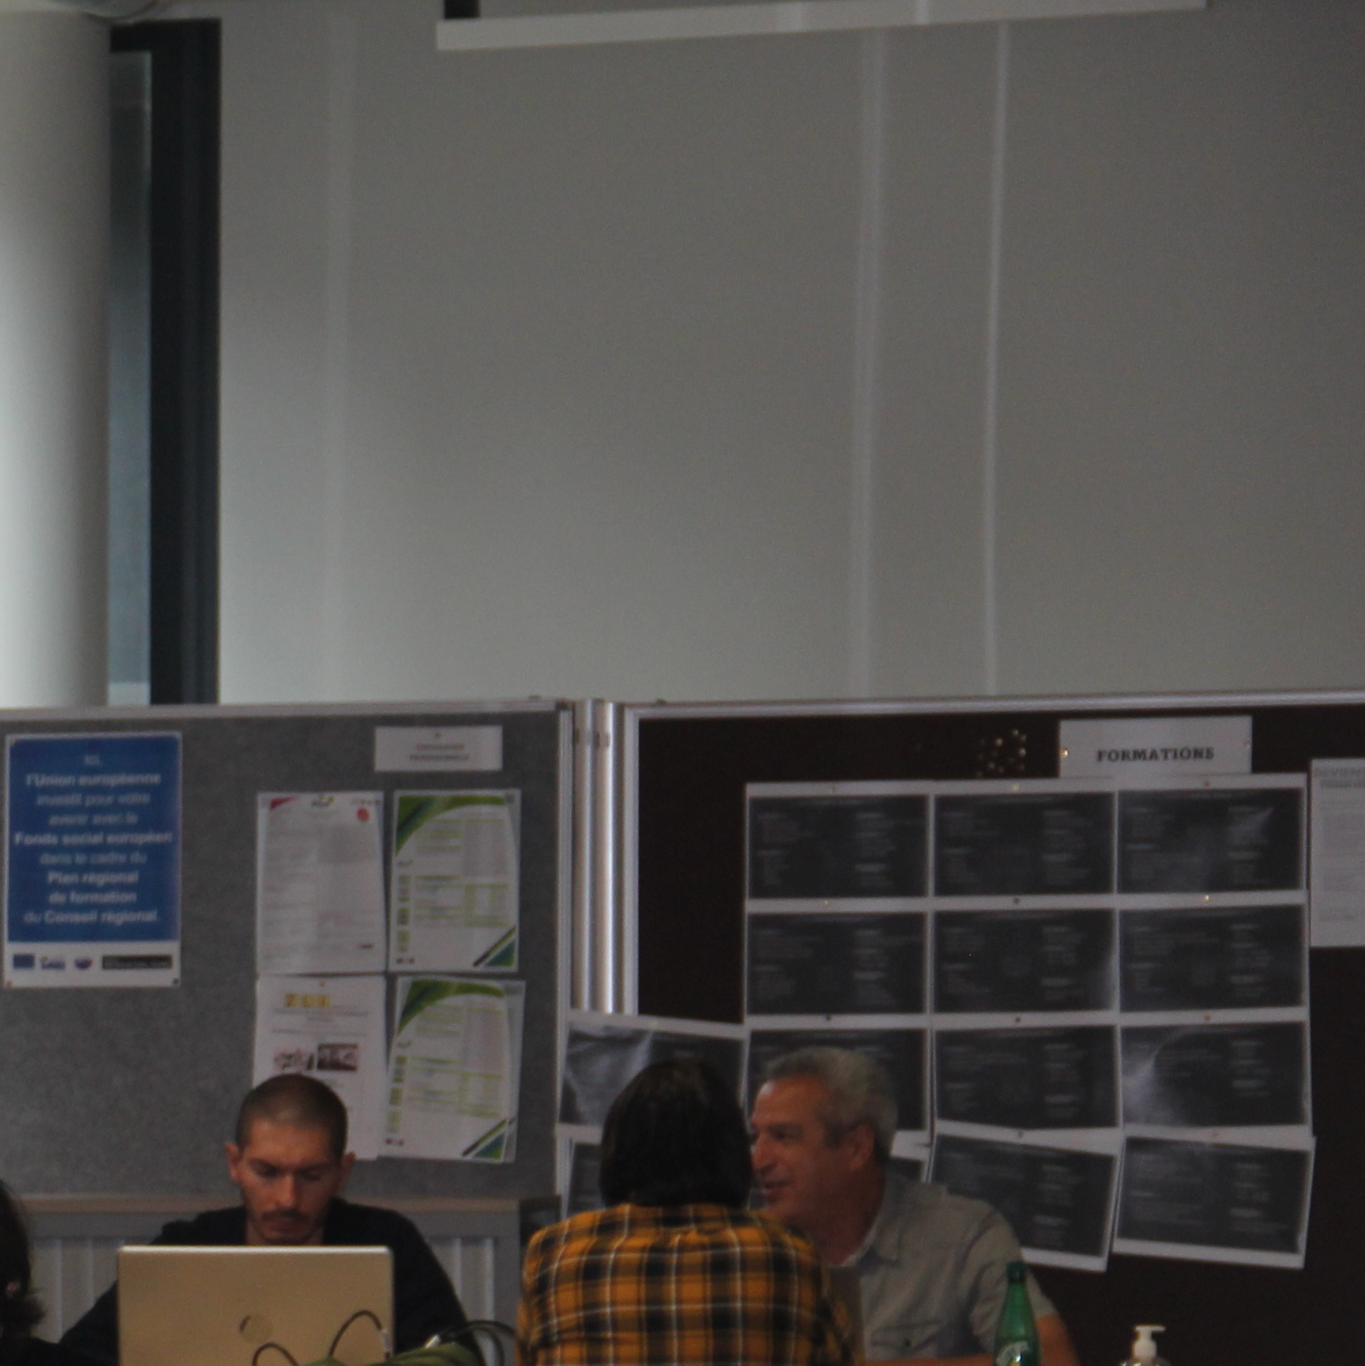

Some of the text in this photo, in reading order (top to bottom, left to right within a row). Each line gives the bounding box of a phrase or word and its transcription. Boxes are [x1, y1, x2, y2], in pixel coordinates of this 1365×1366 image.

[1096, 746, 1216, 763] FORMATIONS
[47, 870, 140, 888] Plan régional
[43, 908, 98, 924] Conseil
